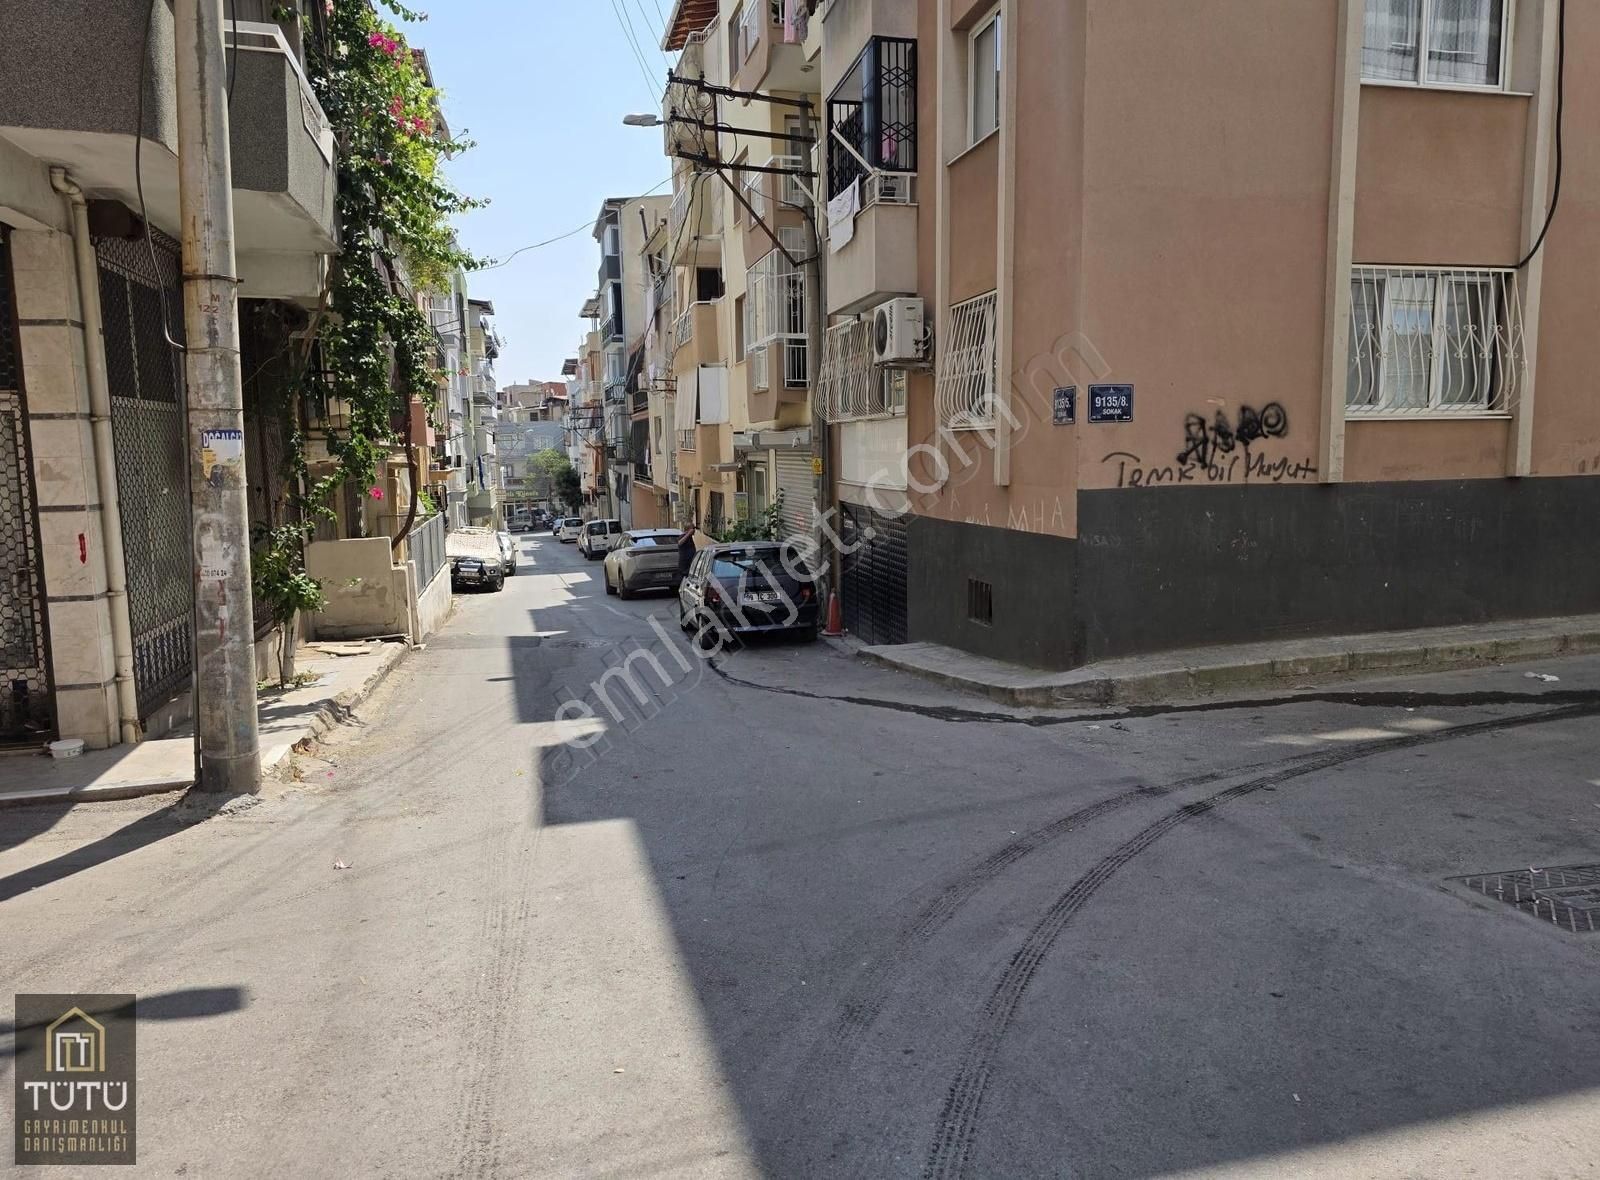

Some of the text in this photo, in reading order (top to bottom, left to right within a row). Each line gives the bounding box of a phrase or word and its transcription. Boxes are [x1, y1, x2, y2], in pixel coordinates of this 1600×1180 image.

[210, 294, 220, 303] M
[199, 304, 219, 314] 122
[1095, 396, 1129, 408] 9135/8.
